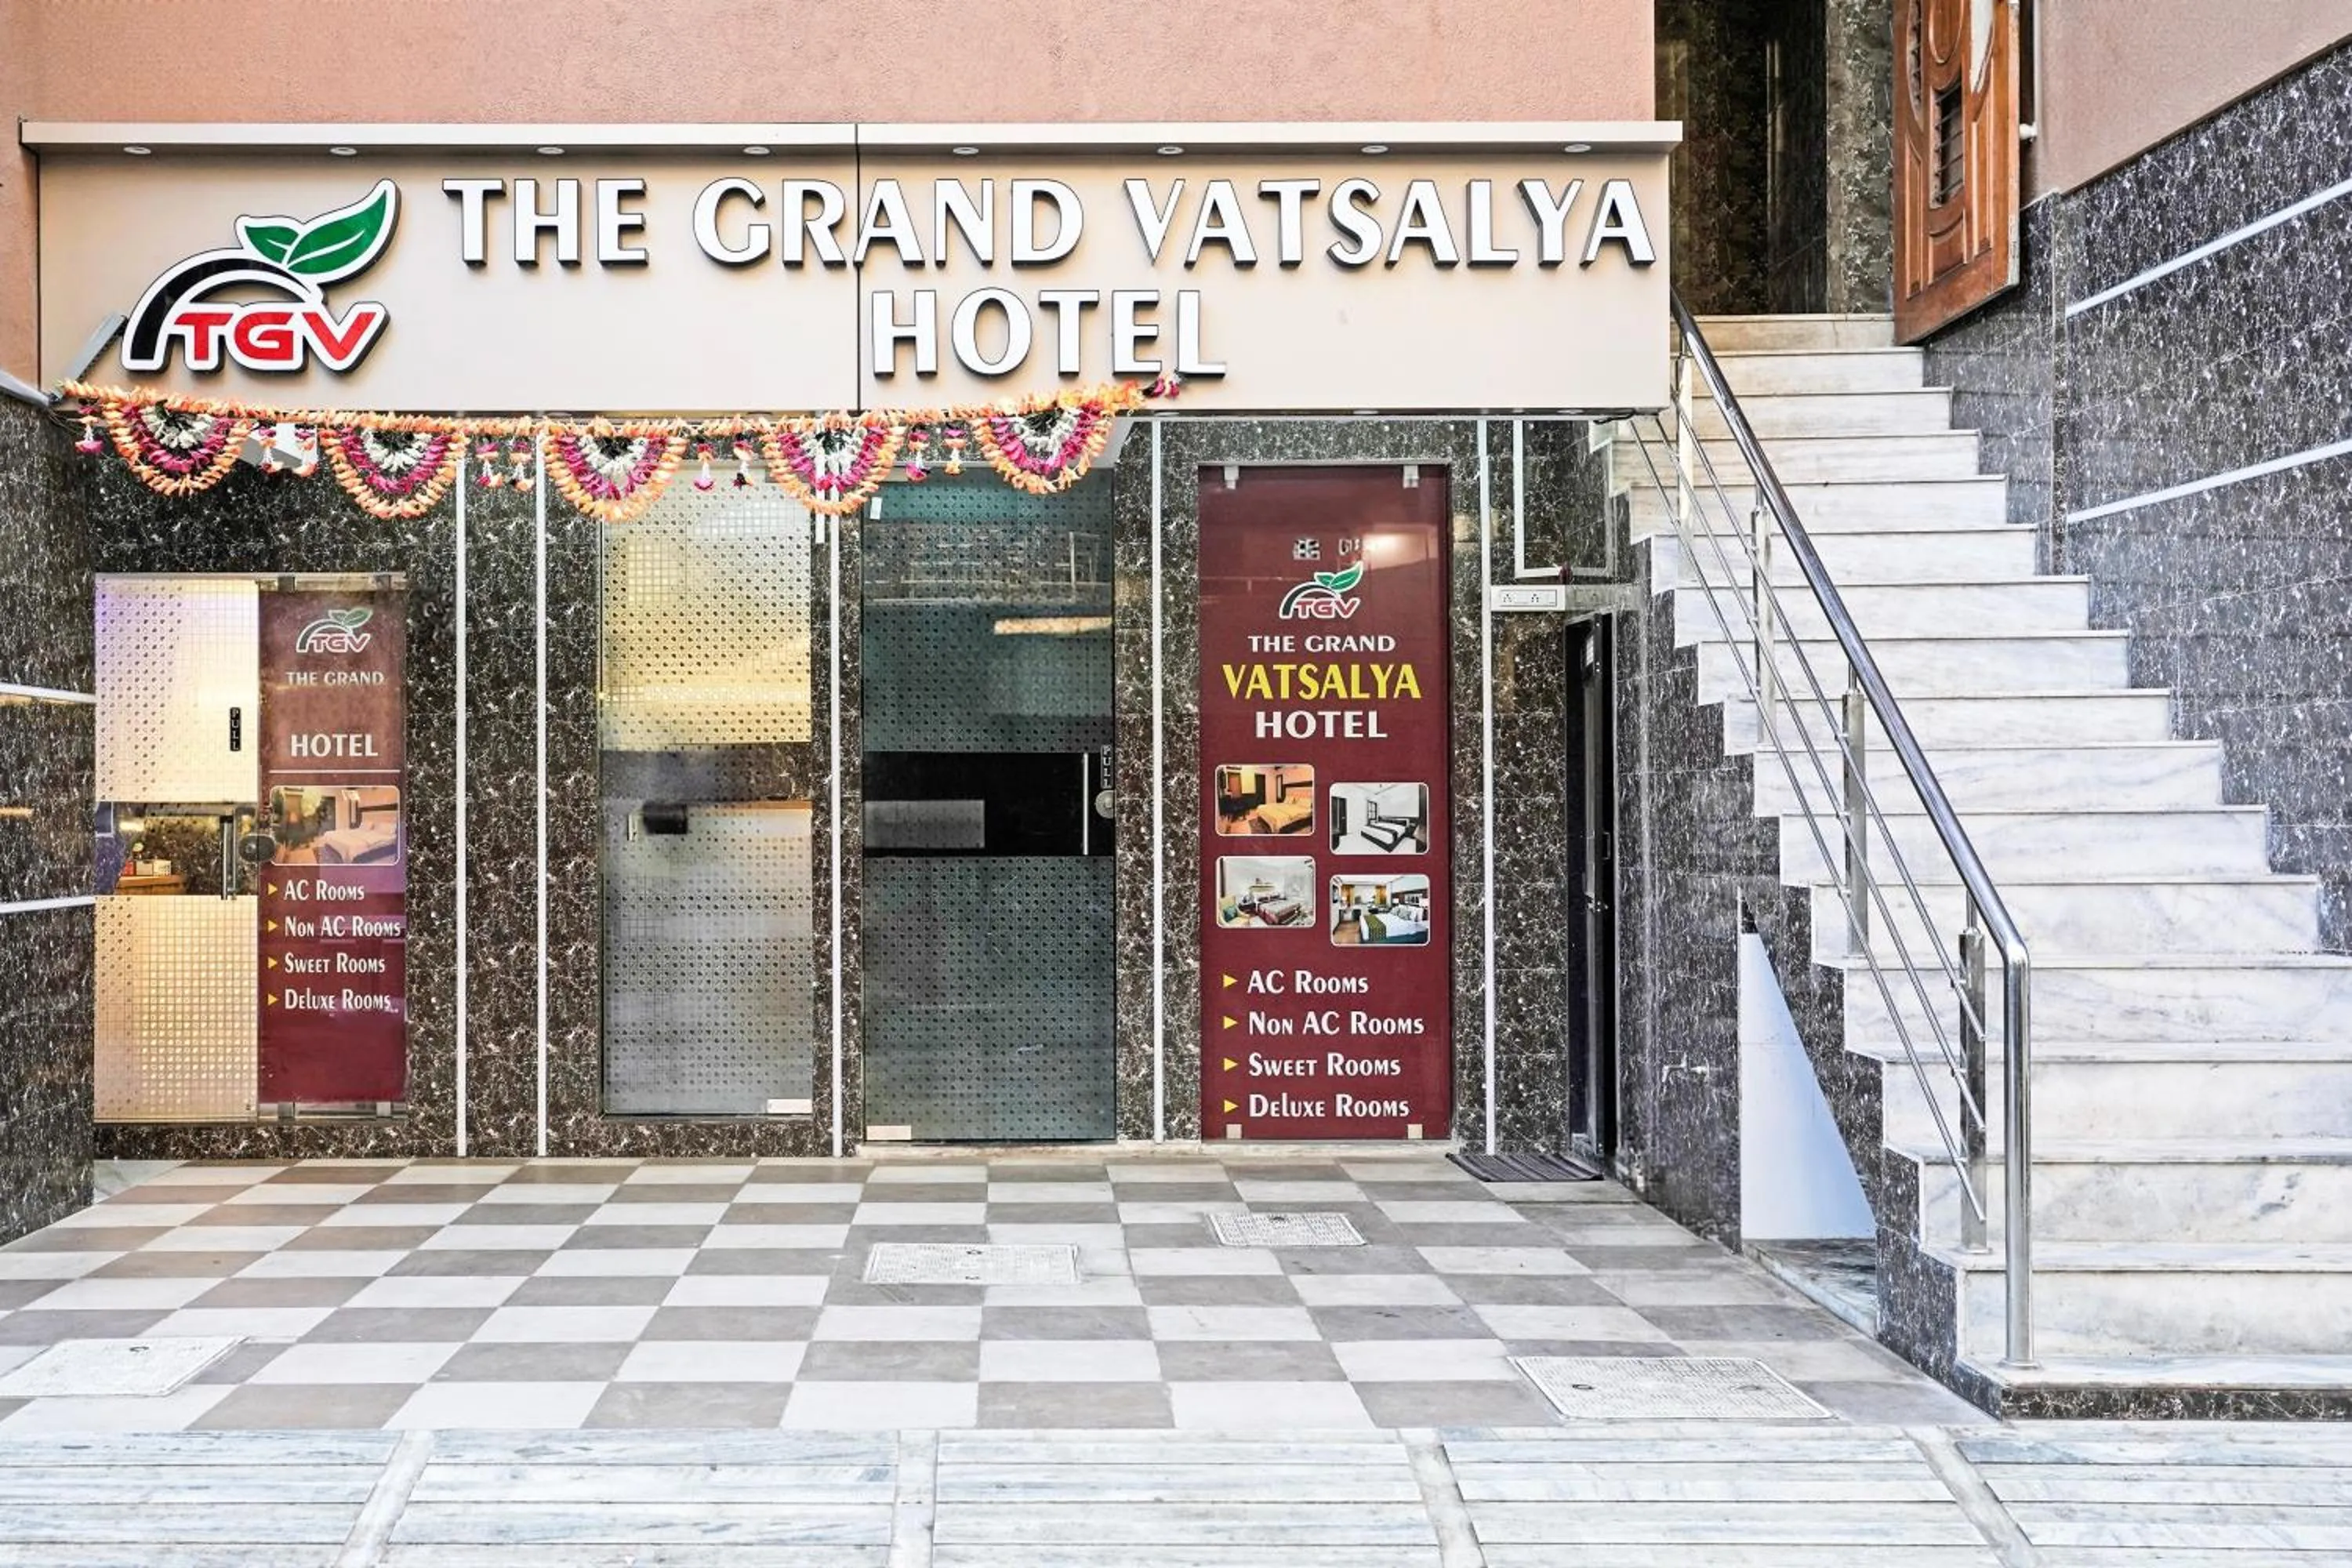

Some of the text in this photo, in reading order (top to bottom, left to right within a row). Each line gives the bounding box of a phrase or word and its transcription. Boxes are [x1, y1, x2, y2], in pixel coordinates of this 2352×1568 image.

[442, 176, 1656, 267] THE GRAND VATSALYA
[168, 304, 387, 369] TGV
[870, 287, 1226, 378] HOTEL
[1294, 597, 1360, 619] TGV
[310, 633, 371, 652] TGV
[1247, 635, 1396, 652] THE GRAND
[286, 671, 384, 686] THE GRAND
[1222, 663, 1422, 700] VATSALYA
[1255, 710, 1388, 738] HOTEL
[290, 734, 378, 757] HOTEL
[284, 879, 309, 901] AC
[321, 916, 346, 937] AC
[1247, 970, 1285, 993] AC
[1302, 1011, 1340, 1035] AC
